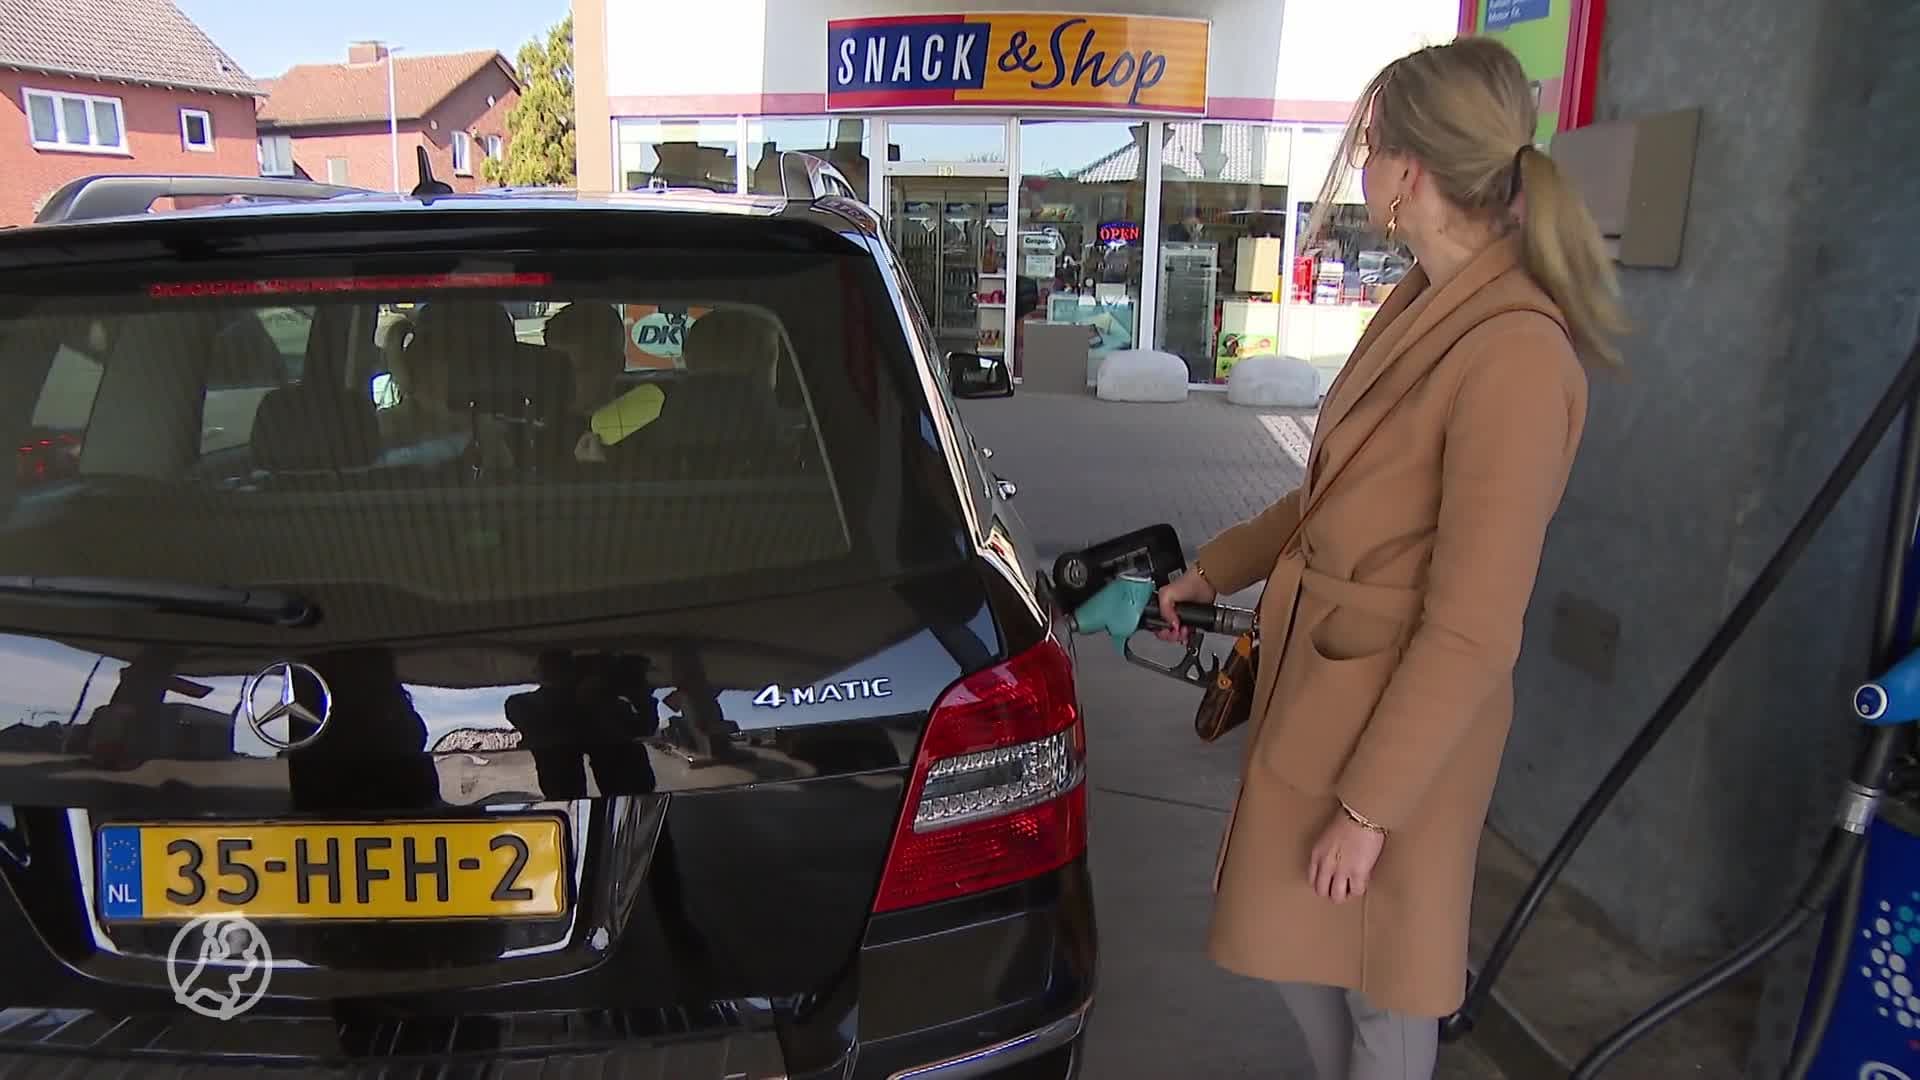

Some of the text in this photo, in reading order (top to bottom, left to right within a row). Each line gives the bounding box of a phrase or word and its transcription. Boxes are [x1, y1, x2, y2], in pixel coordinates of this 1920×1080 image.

[838, 19, 1165, 104] SNACK & Shop
[1099, 226, 1140, 241] OPEN
[638, 326, 684, 344] DK
[165, 834, 534, 906] 35-HFH-2
[107, 884, 137, 903] NL
